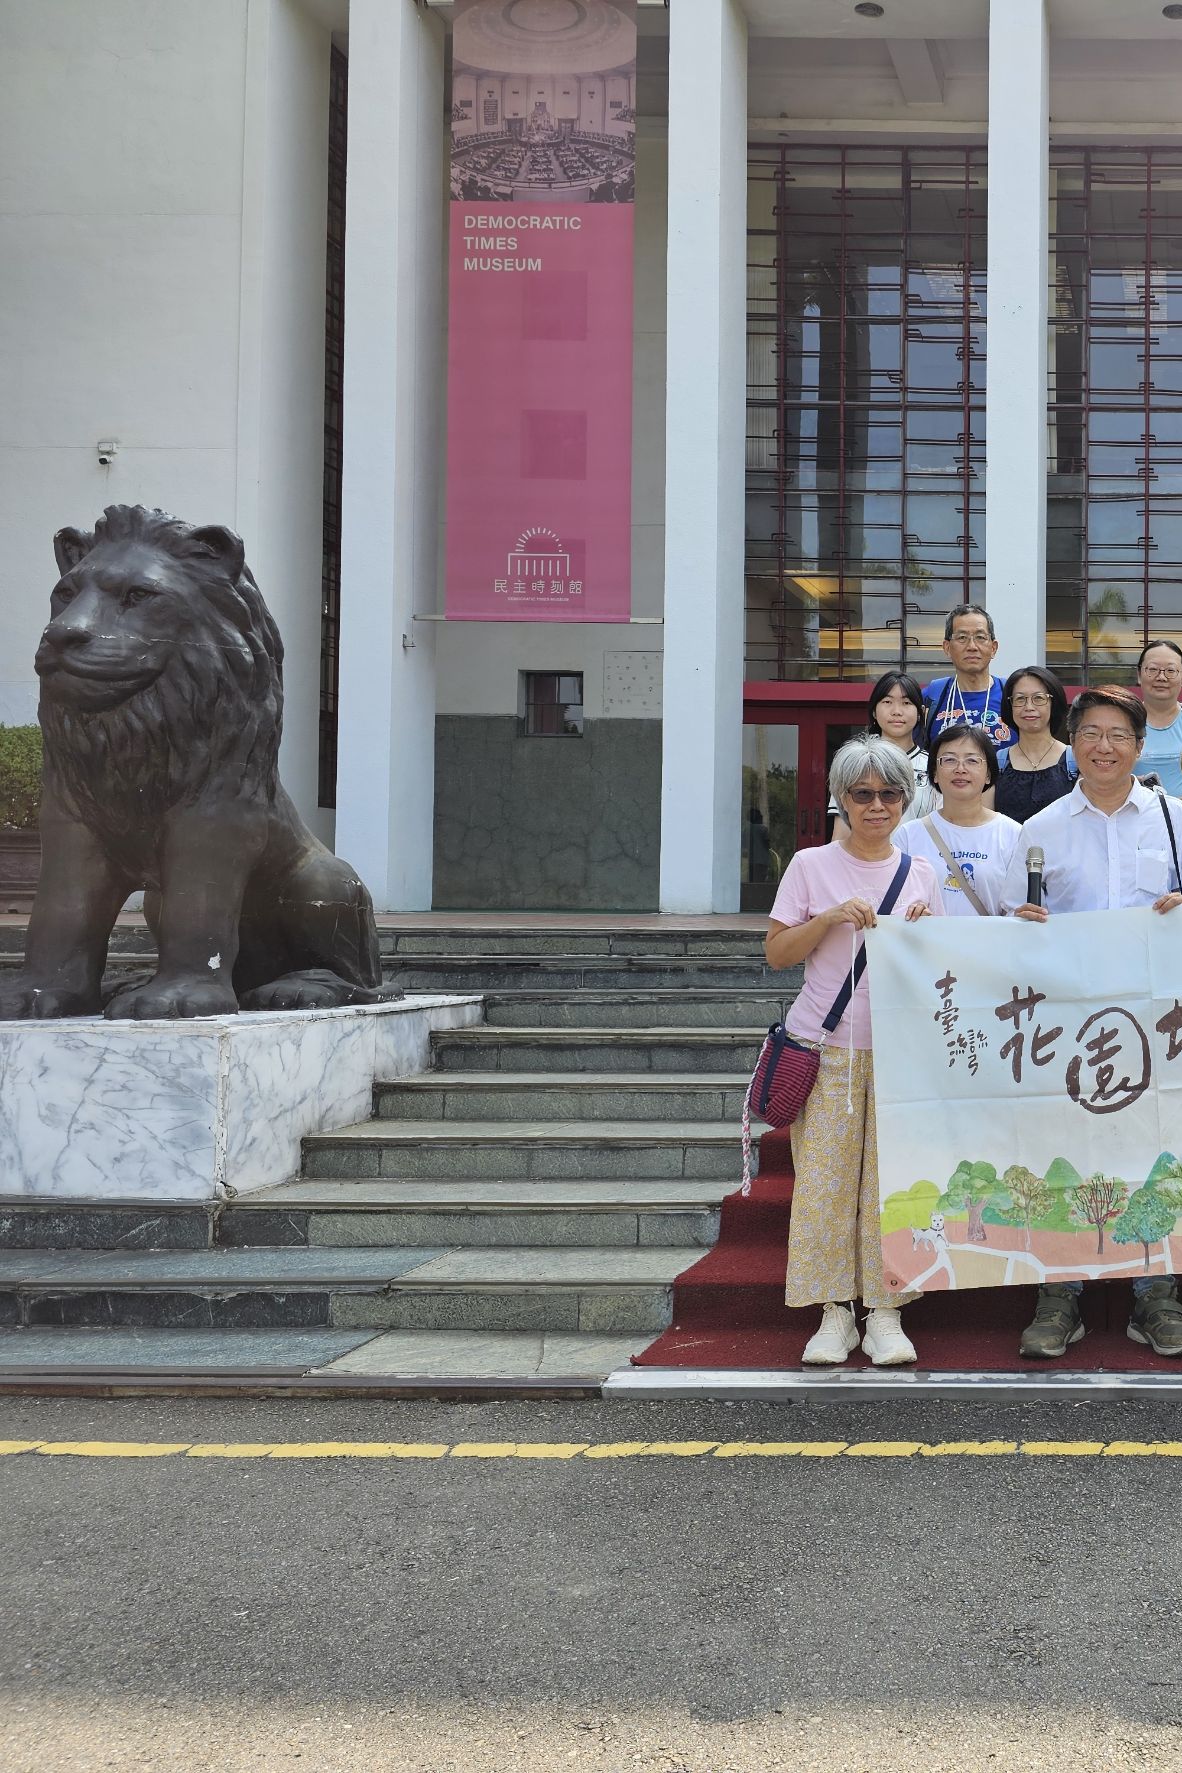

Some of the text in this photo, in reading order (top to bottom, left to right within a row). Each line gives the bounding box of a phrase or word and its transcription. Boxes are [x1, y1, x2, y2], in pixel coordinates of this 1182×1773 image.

[464, 215, 582, 230] DEMOCRATIC
[463, 236, 518, 250] TIMES
[463, 257, 542, 272] MUSEUM
[494, 579, 583, 594] 民主時刻館
[939, 851, 988, 860] CLDHOOD
[934, 970, 988, 1076] 臺灣
